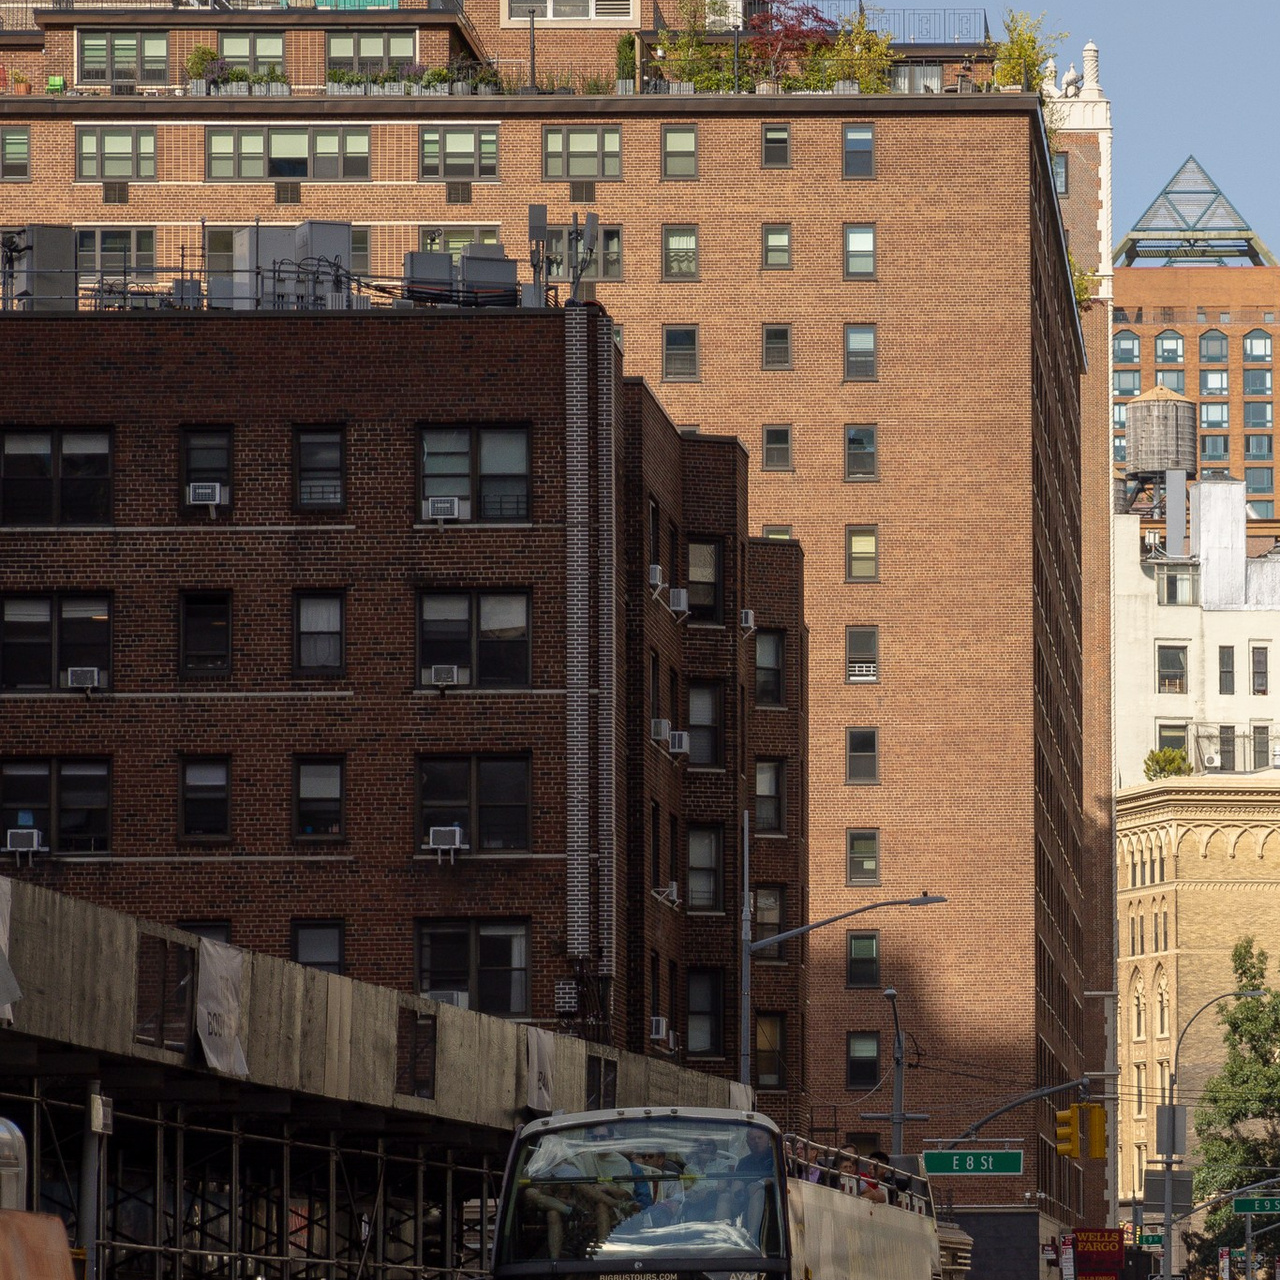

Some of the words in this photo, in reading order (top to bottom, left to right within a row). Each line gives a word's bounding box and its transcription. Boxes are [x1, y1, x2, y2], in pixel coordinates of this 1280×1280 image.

[953, 1156, 959, 1169] E
[966, 1156, 974, 1169] 8
[980, 1155, 993, 1169] St
[1254, 1201, 1260, 1210] E
[1265, 1201, 1270, 1210] 9
[1076, 1232, 1119, 1241] WELLS
[1077, 1242, 1119, 1251] FARGO
